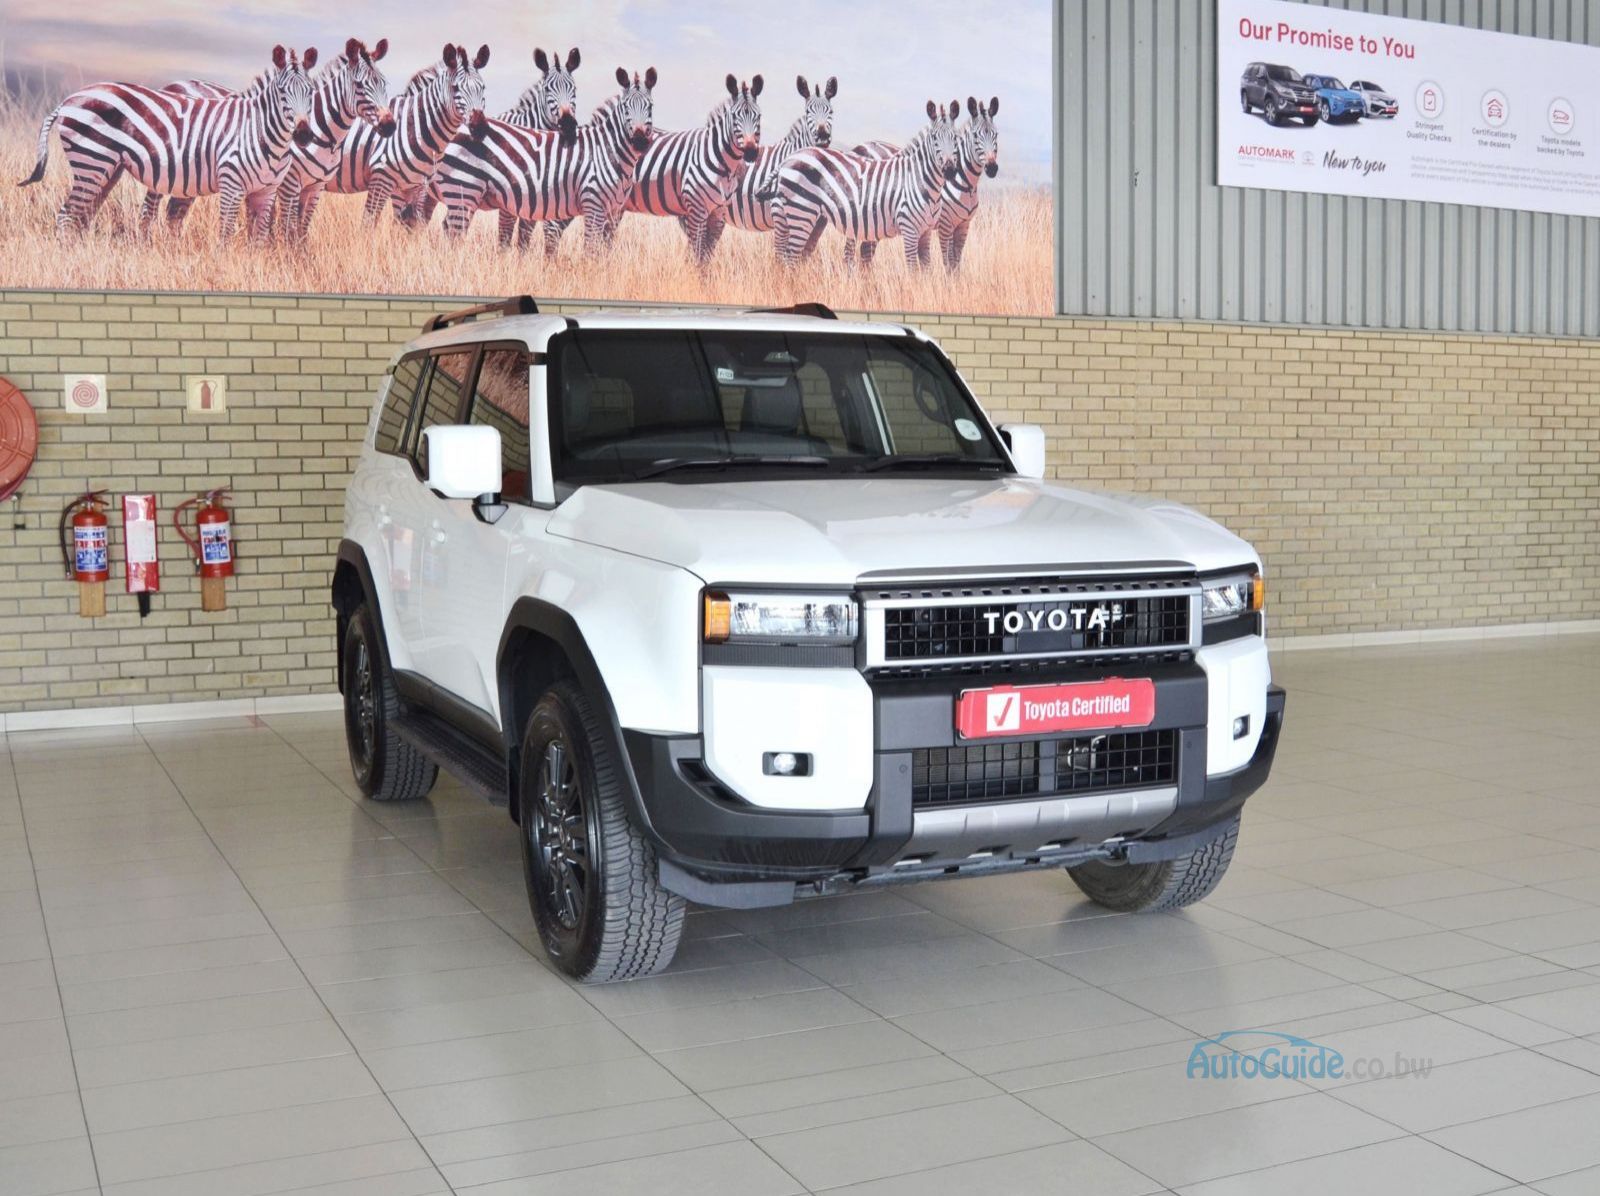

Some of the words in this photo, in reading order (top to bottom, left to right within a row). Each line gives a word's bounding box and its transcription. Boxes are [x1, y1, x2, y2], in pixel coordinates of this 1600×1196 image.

[1239, 17, 1273, 41] Our
[1277, 22, 1354, 51] Promise
[1359, 34, 1378, 54] to
[1382, 36, 1416, 59] You
[1415, 121, 1444, 131] Stringent
[1406, 130, 1428, 141] Quality
[1429, 133, 1452, 142] Checks
[1471, 127, 1510, 139] Certification
[1489, 141, 1511, 149] dealers
[1541, 135, 1560, 145] Toyota
[1560, 139, 1581, 147] models
[1238, 145, 1295, 160] AUTOMARK
[1566, 148, 1585, 157] Toyota
[1350, 155, 1363, 170] to
[1362, 159, 1386, 177] you
[983, 607, 1106, 635] TOYOTA
[1024, 697, 1069, 721] Toyota
[1071, 694, 1130, 716] Certified
